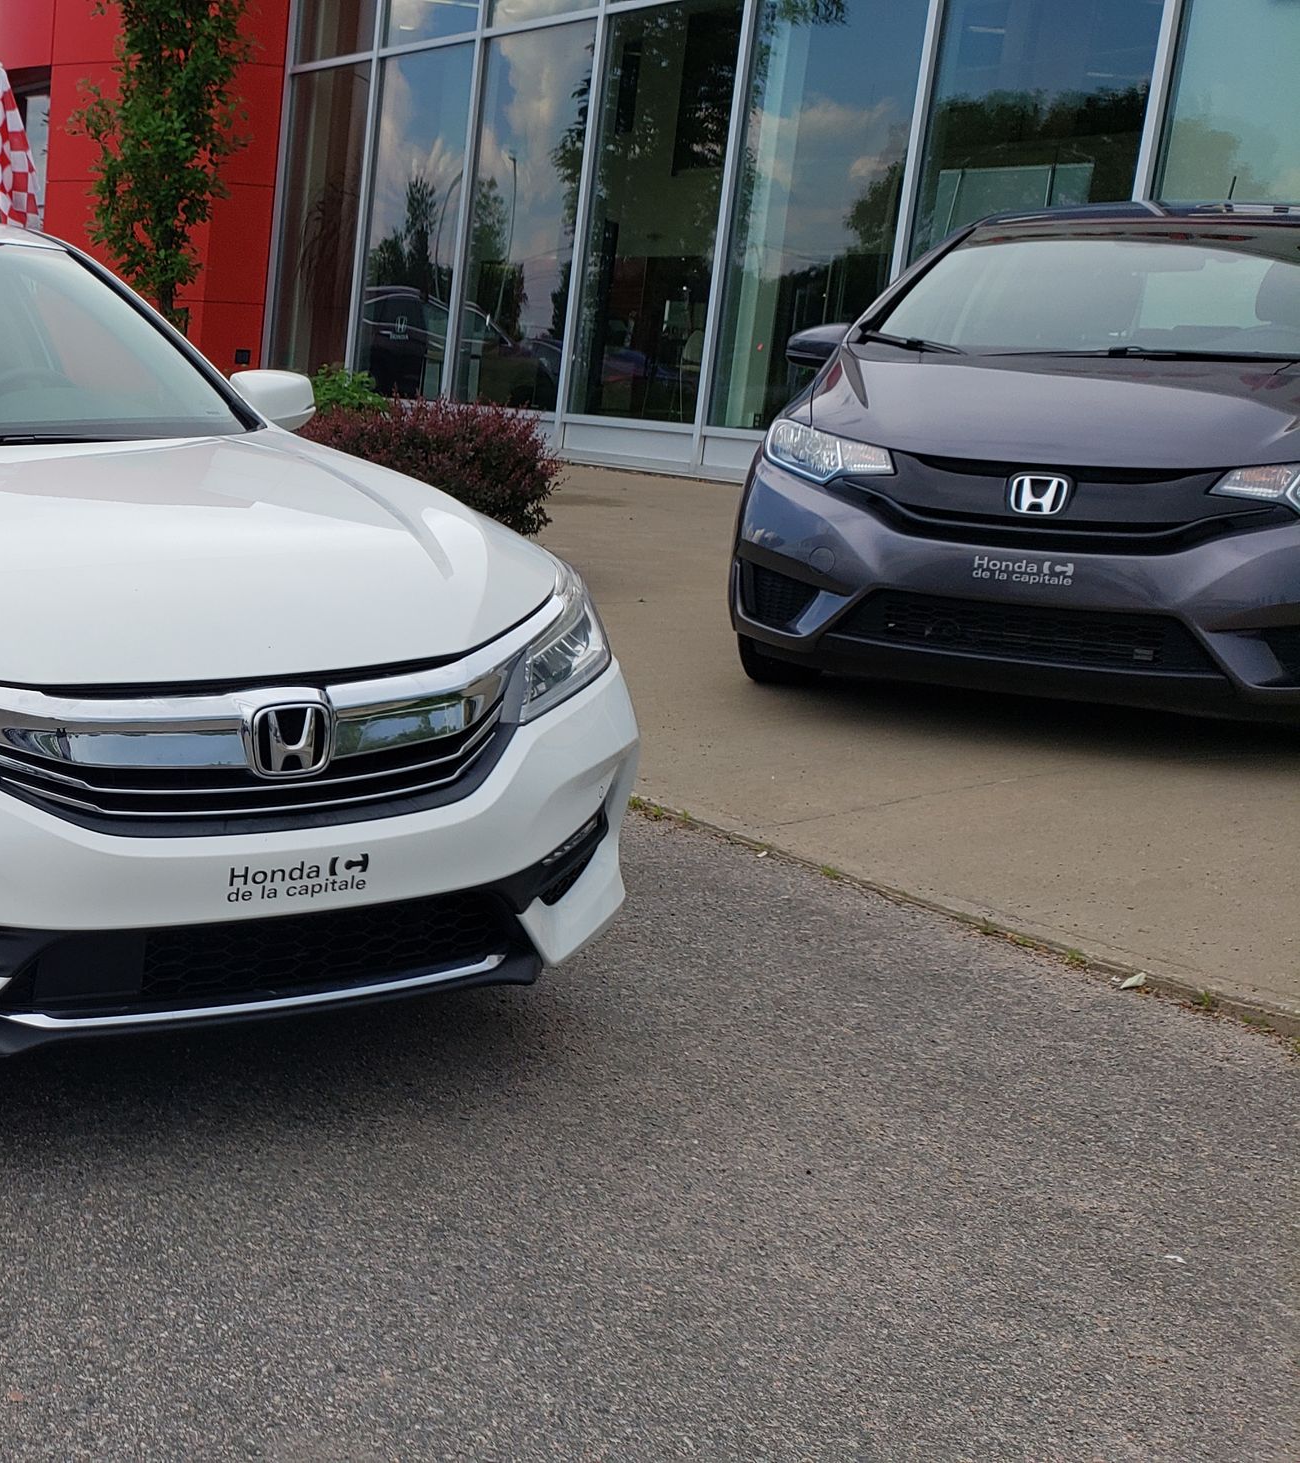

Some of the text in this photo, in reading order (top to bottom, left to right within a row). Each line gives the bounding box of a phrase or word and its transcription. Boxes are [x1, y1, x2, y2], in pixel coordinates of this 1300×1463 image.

[973, 555, 1038, 573] Honda
[972, 568, 1072, 586] de la capitale
[229, 860, 321, 887] Honda
[227, 875, 367, 902] de la capitale
